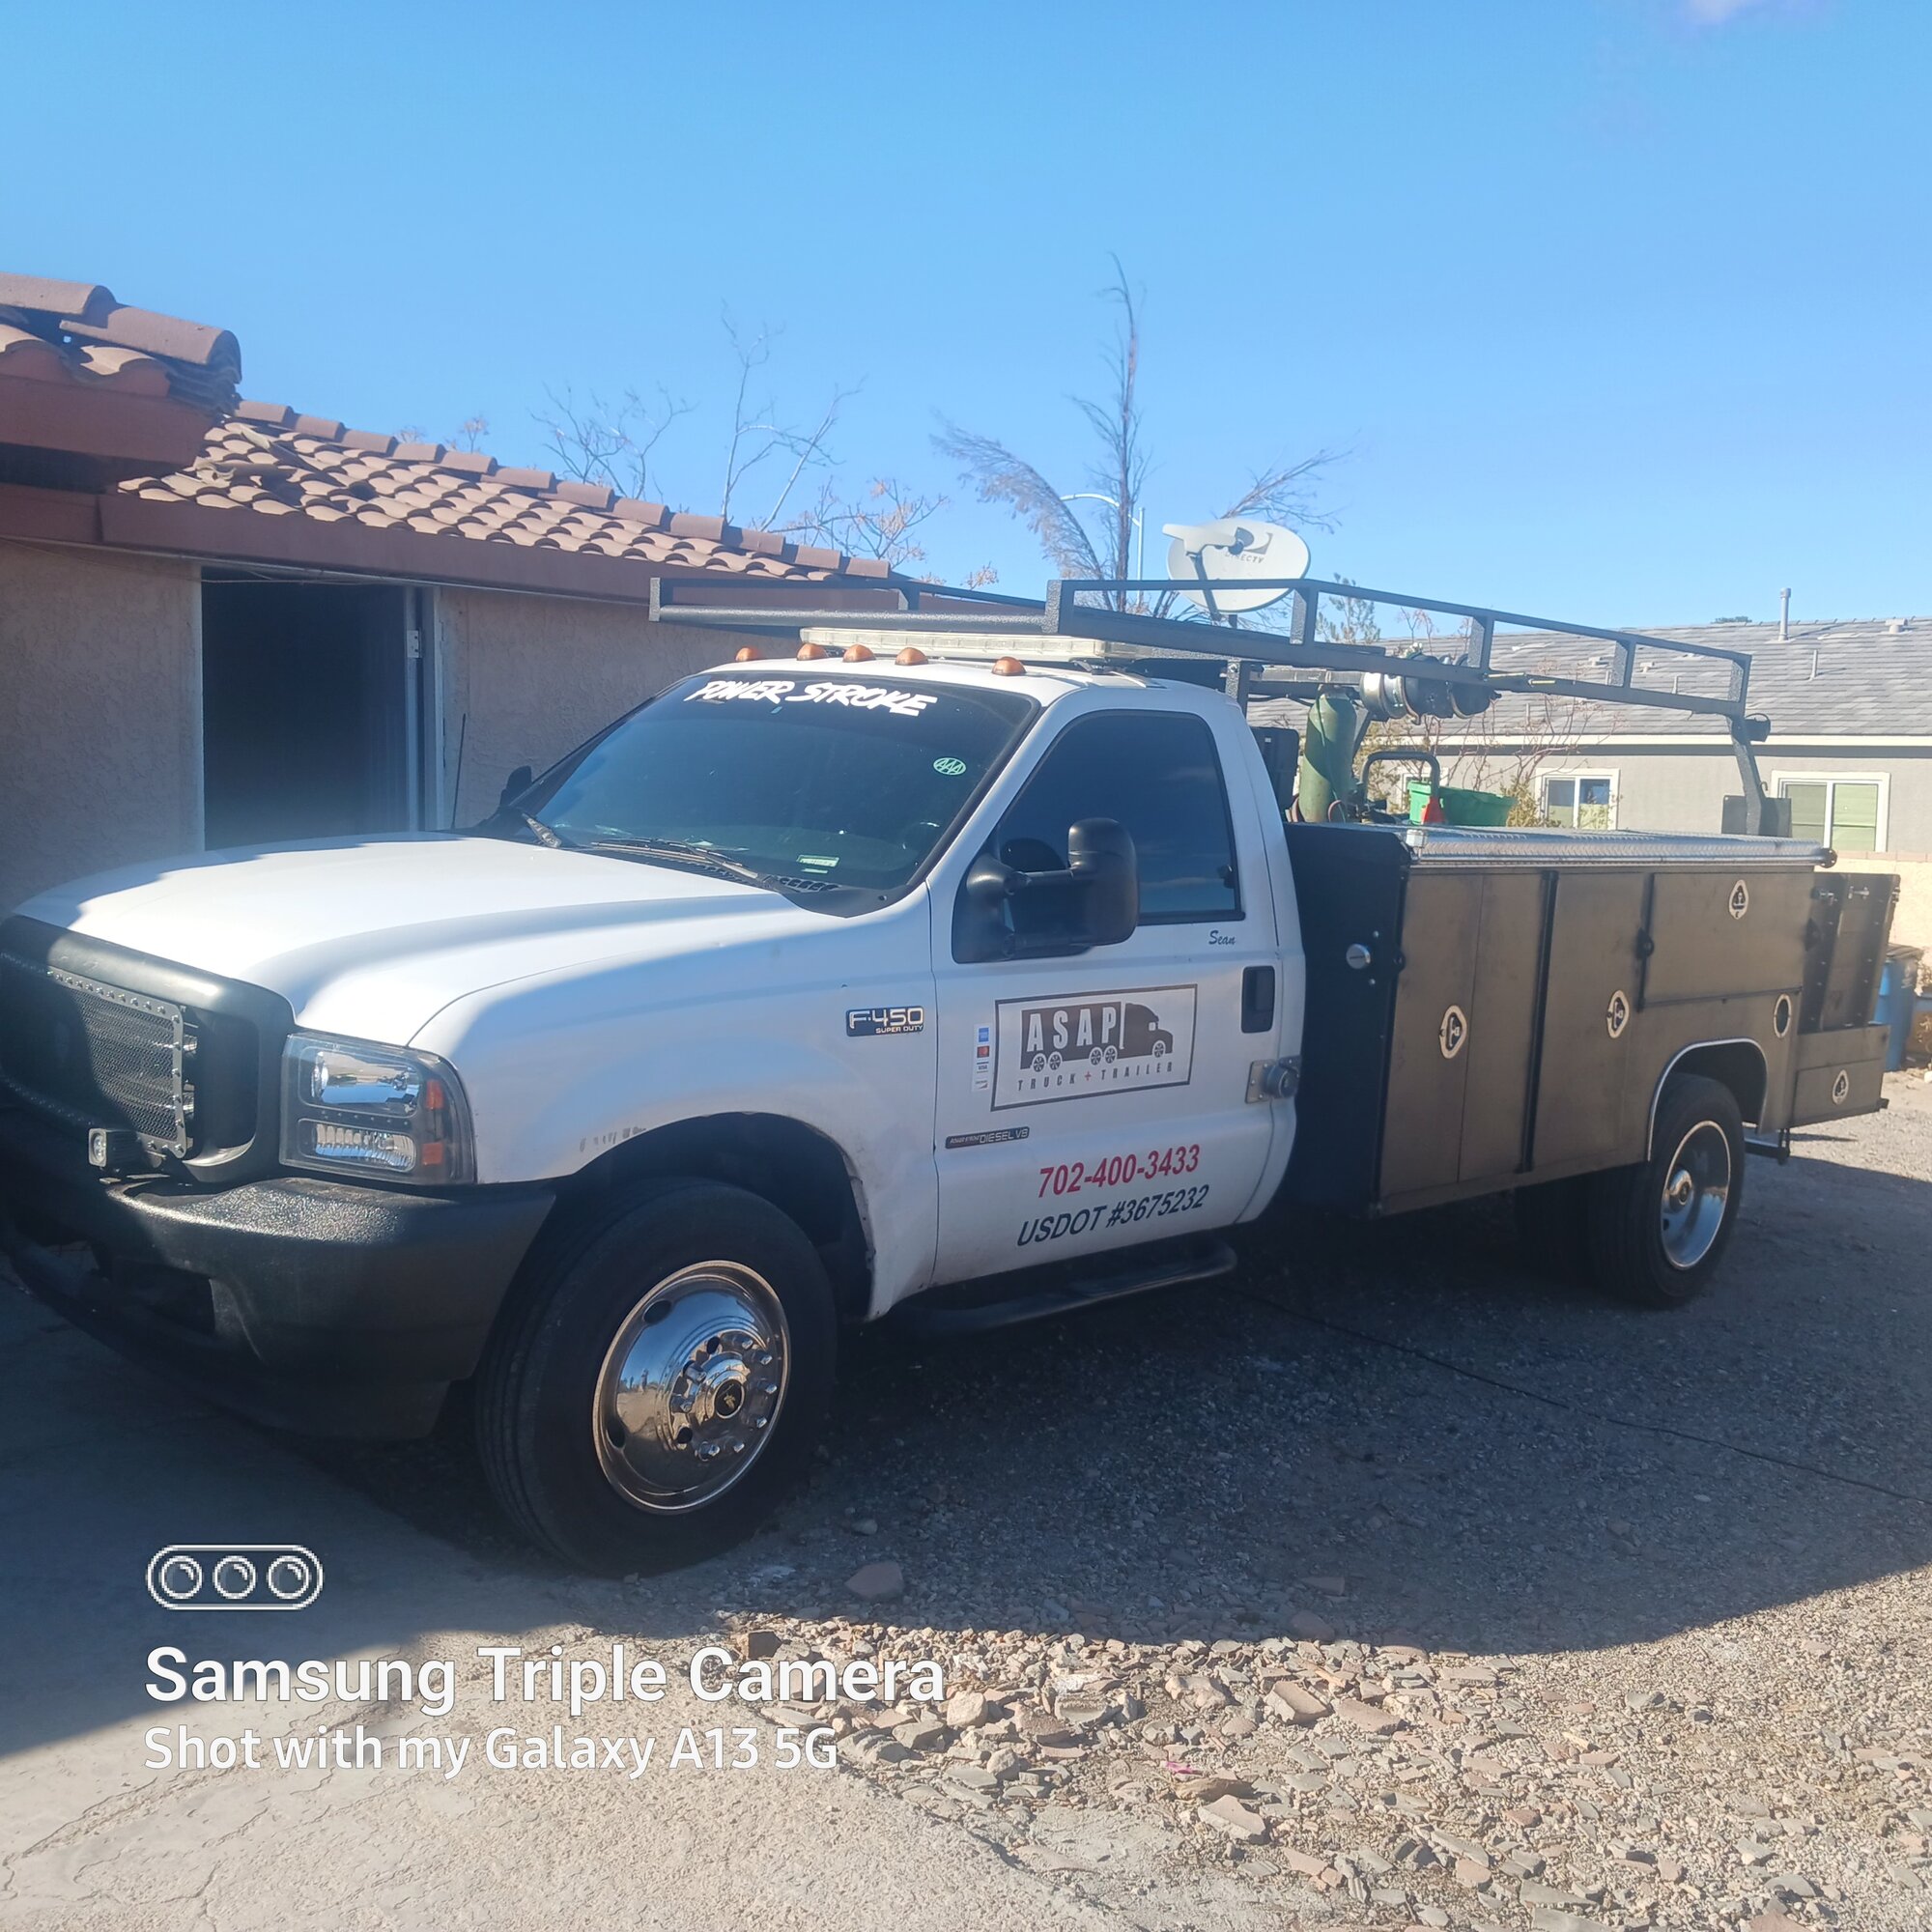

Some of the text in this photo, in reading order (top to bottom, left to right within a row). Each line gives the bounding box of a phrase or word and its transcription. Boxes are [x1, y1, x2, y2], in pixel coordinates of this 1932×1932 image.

[684, 680, 938, 717] POWER STROKE
[933, 757, 967, 776] AAA
[1208, 929, 1236, 946] Sean
[849, 1007, 923, 1029] F-450
[1026, 1007, 1117, 1052] ASAP
[1017, 1073, 1077, 1091] TRUCK
[1100, 1062, 1174, 1081] TRAILER
[979, 1130, 1014, 1144] DIESEL
[1015, 1128, 1029, 1139] V8
[1037, 1144, 1201, 1199] 702-400-3433
[1017, 1183, 1209, 1246] USDOT #3675232
